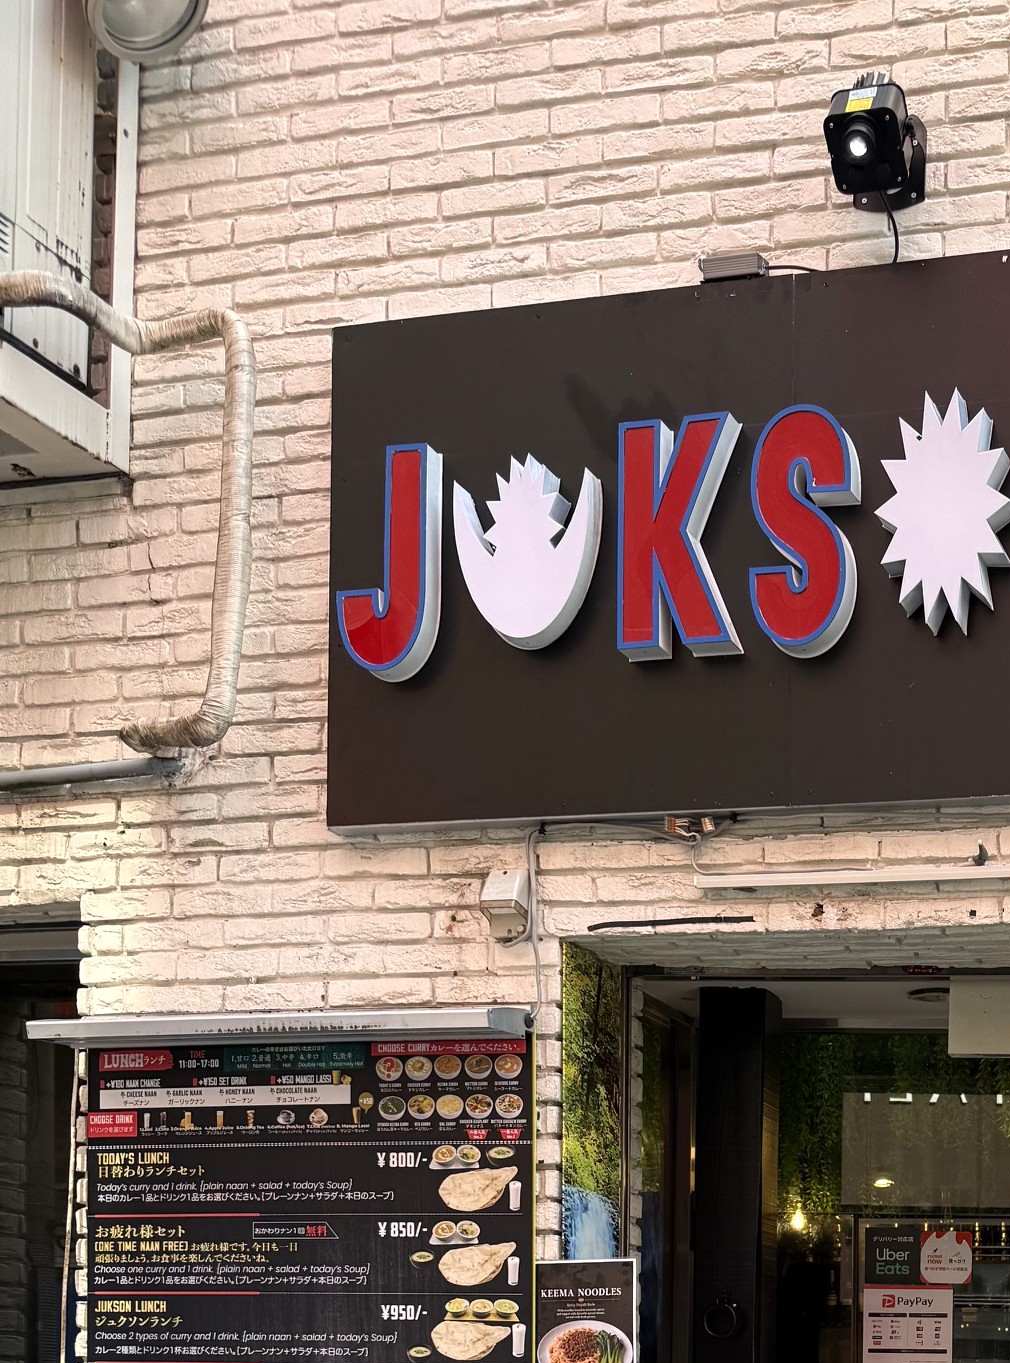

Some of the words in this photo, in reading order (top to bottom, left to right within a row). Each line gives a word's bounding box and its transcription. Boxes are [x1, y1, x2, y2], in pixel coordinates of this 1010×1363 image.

[103, 1053, 143, 1070] LUNCH
[144, 1054, 166, 1066] ランチ
[97, 1153, 135, 1165] TODAY'S
[138, 1153, 169, 1164] LUNCH
[97, 1164, 205, 1178] 日替わりランチセット
[95, 1225, 185, 1238] お疲れ様セット
[876, 1248, 910, 1260] Uber
[876, 1263, 910, 1274] Eats
[541, 1288, 574, 1298] KEEMA
[578, 1288, 622, 1296] NOODLES
[94, 1302, 131, 1313] JUKSON
[136, 1302, 166, 1312] LUNCH
[897, 1297, 933, 1307] PayPay
[381, 1304, 428, 1320] ¥950/-
[95, 1315, 183, 1327] ジュクソンランチ
